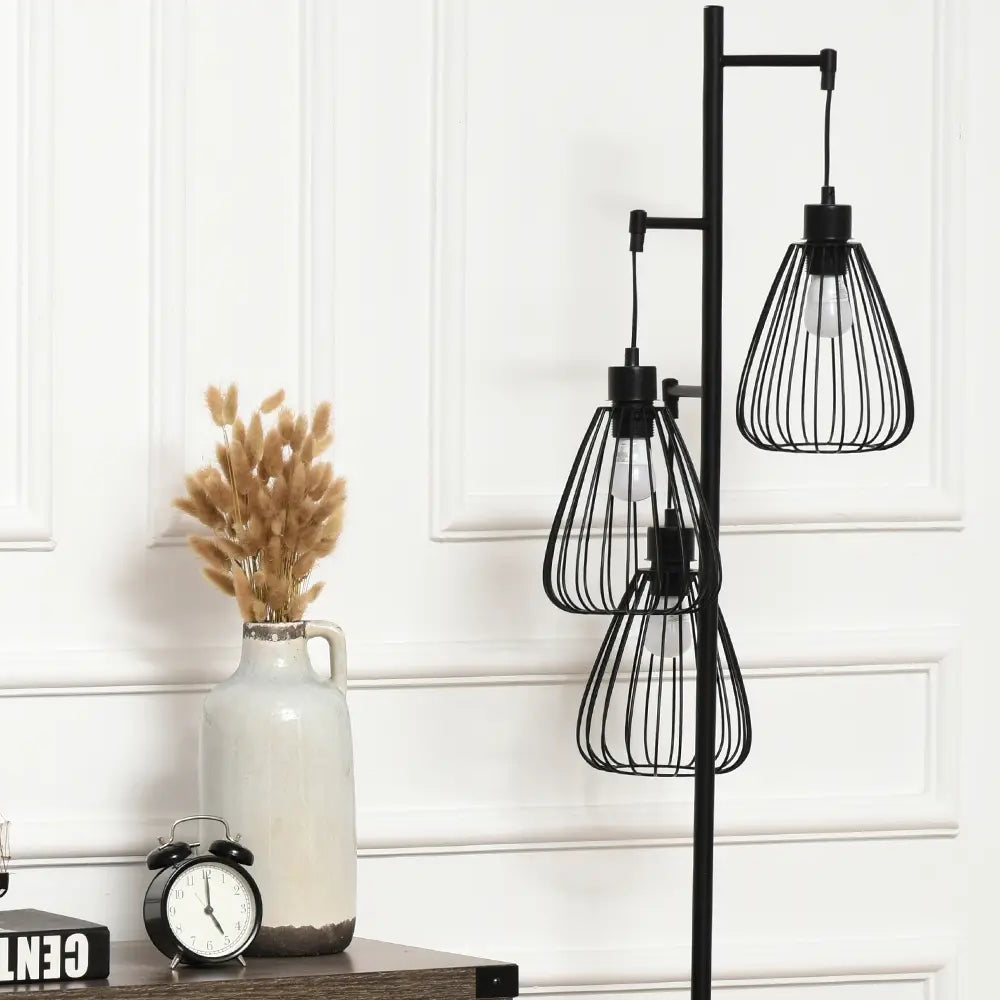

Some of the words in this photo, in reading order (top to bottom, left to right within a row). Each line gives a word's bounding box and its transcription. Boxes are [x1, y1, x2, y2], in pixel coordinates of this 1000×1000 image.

[175, 890, 184, 900] 10
[232, 886, 240, 896] 2
[240, 904, 246, 914] 3
[206, 940, 213, 950] 6
[224, 936, 230, 946] 5
